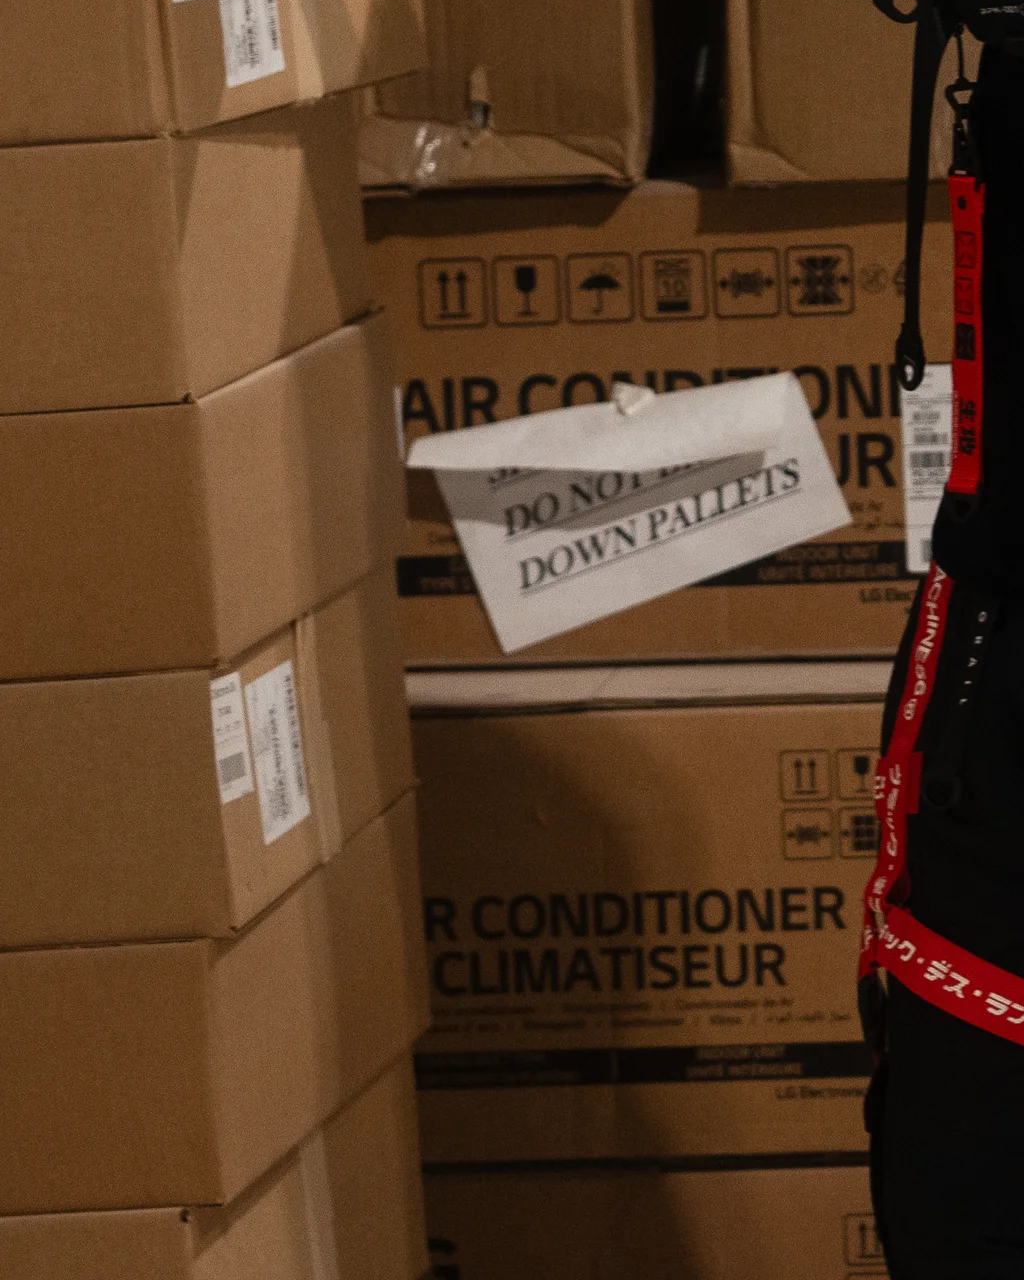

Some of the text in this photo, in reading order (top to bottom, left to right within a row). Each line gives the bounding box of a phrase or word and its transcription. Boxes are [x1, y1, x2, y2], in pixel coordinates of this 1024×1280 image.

[503, 492, 560, 537] DO
[518, 519, 638, 589] DOWN
[647, 458, 800, 541] PALLETS
[472, 886, 846, 940] CONDITIONER
[434, 943, 787, 996] CLIMATISEUR
